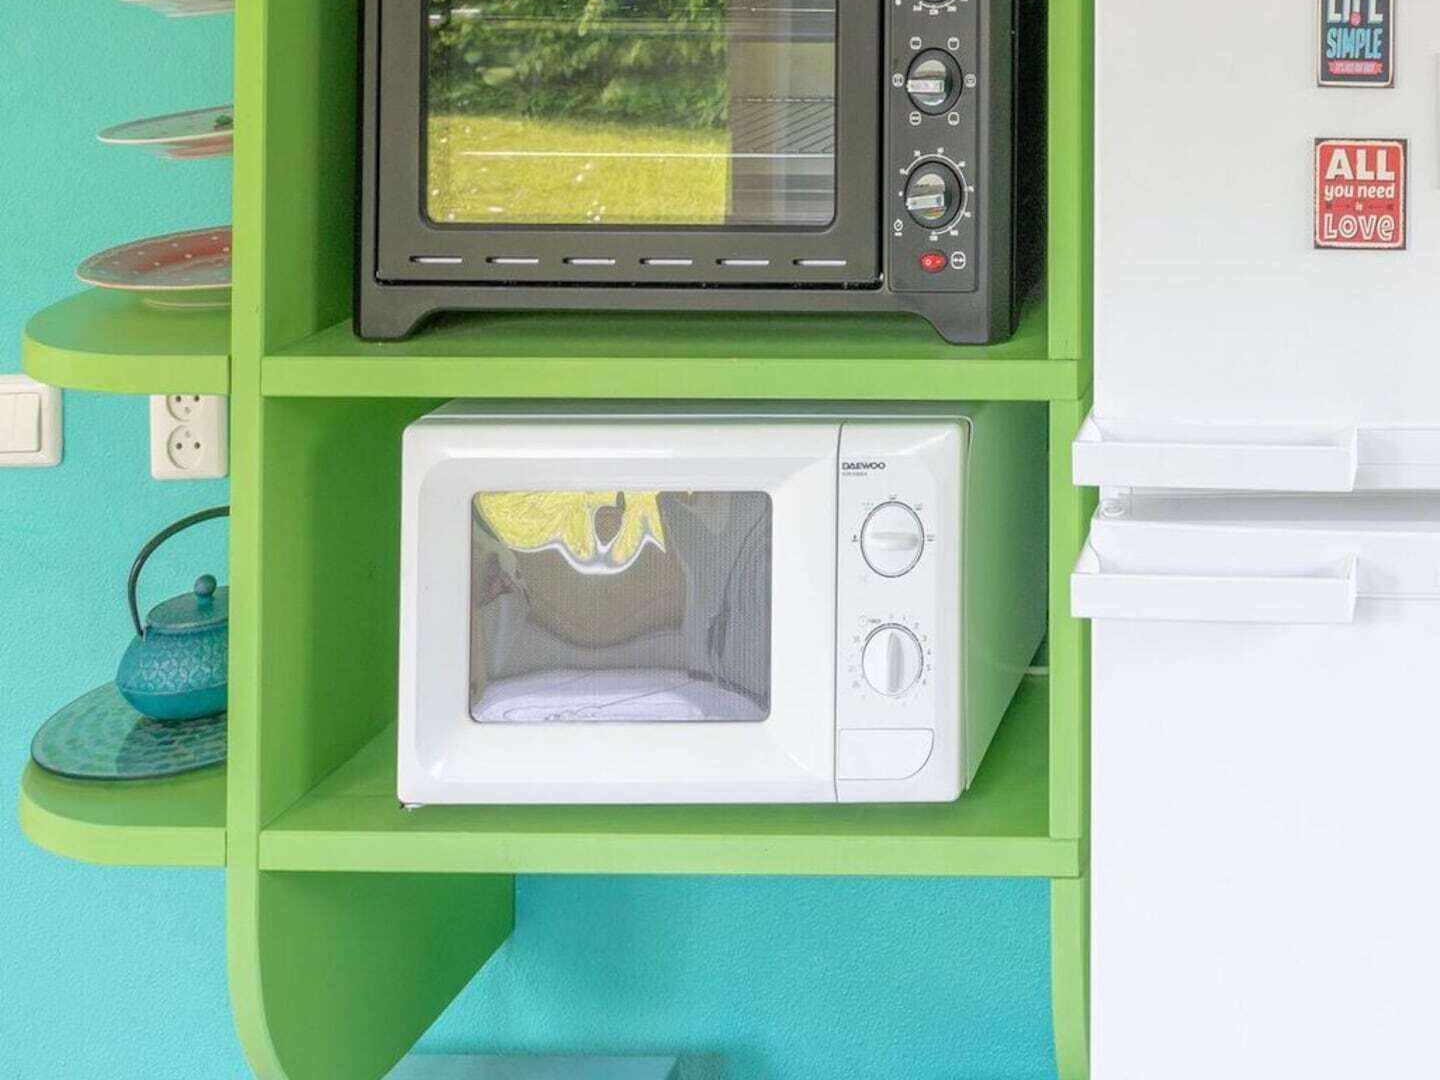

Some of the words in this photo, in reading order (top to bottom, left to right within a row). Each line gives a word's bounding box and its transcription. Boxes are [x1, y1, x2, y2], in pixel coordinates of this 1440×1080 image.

[1326, 27, 1383, 59] SIMPLE
[1325, 148, 1395, 181] ALL
[1324, 184, 1354, 201] you
[1357, 182, 1395, 199] need
[841, 461, 886, 470] DAEWOO
